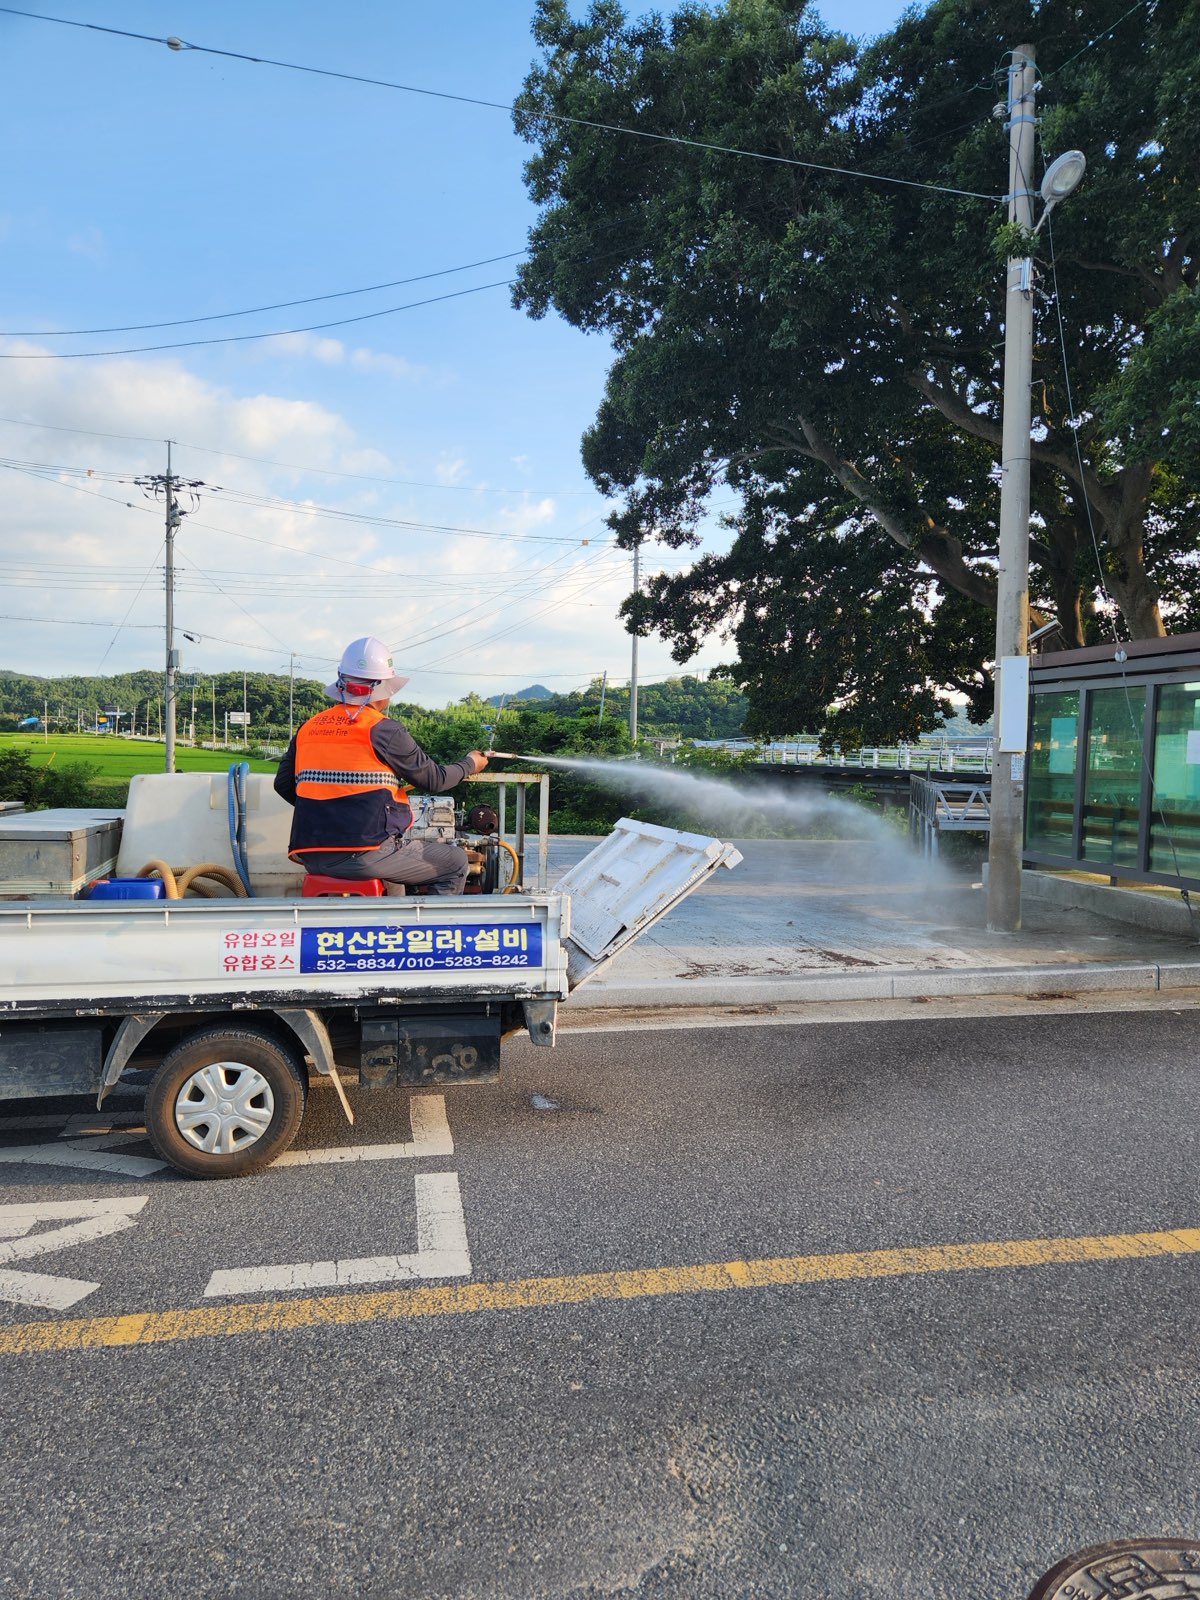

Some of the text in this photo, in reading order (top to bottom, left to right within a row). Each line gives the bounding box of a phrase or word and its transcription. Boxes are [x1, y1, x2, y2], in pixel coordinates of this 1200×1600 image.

[335, 728, 348, 737] Fire
[223, 932, 295, 949] 유압오일
[222, 954, 295, 973] 유합호스
